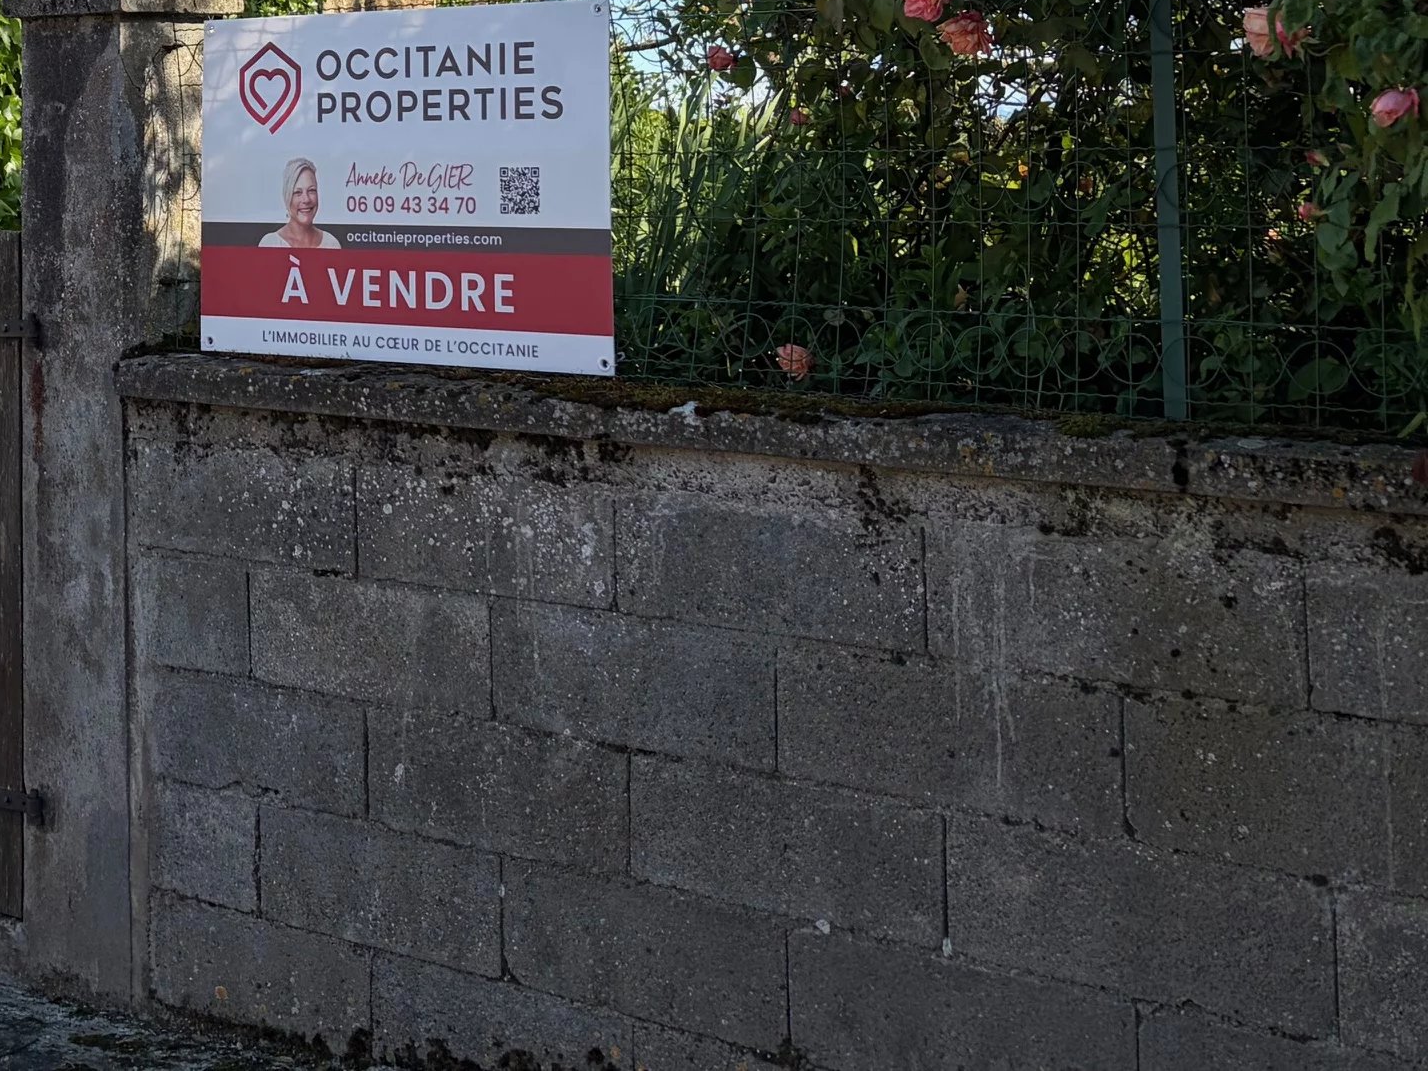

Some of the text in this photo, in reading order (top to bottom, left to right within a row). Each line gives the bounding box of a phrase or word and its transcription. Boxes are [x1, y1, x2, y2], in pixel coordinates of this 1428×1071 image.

[316, 41, 535, 81] OCCITANIE
[317, 85, 563, 123] PROPERTIES
[347, 196, 476, 215] 06 09 43 34 70
[347, 231, 502, 247] occitanieproperties.com
[281, 255, 515, 313] À VENDRE
[353, 335, 371, 348] AU
[424, 339, 442, 353] DE
